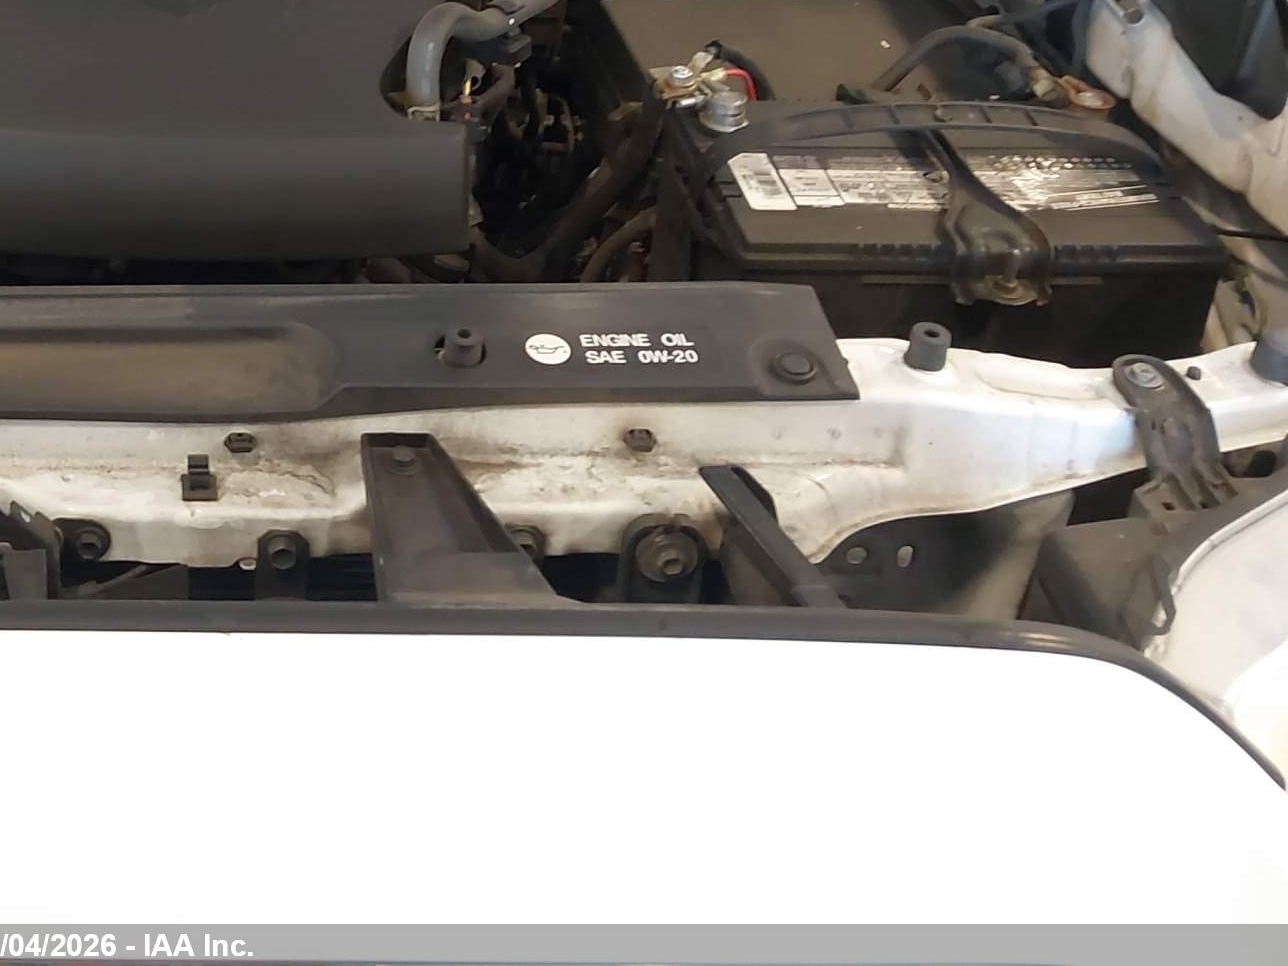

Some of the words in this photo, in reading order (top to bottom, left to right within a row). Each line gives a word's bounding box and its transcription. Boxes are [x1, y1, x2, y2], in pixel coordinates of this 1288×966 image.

[579, 333, 652, 347] ENGINE
[660, 333, 695, 347] OIL
[584, 350, 628, 364] SAE
[637, 349, 699, 364] 0W-20
